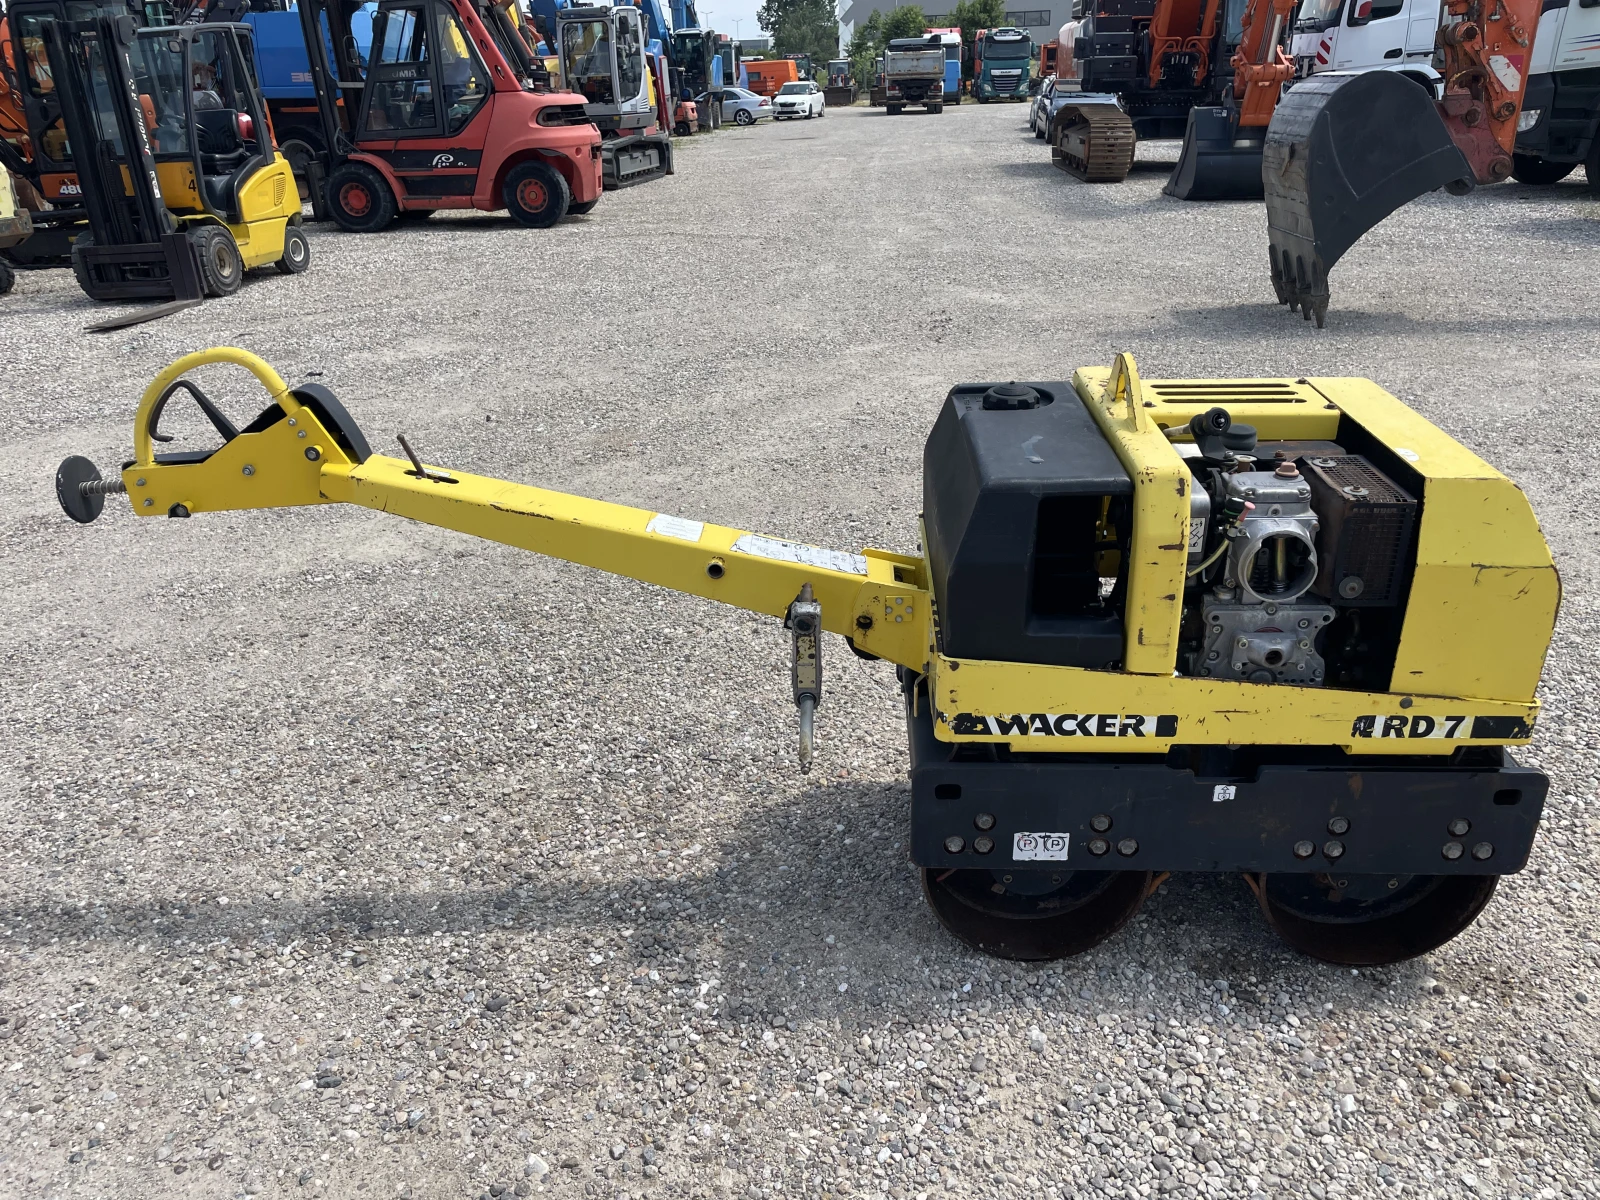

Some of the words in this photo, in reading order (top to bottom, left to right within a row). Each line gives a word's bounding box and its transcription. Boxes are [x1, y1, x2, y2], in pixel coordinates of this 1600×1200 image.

[188, 178, 197, 192] 4
[1000, 713, 1147, 737] WACKER
[1381, 715, 1435, 738] RD
[1444, 716, 1466, 738] 7
